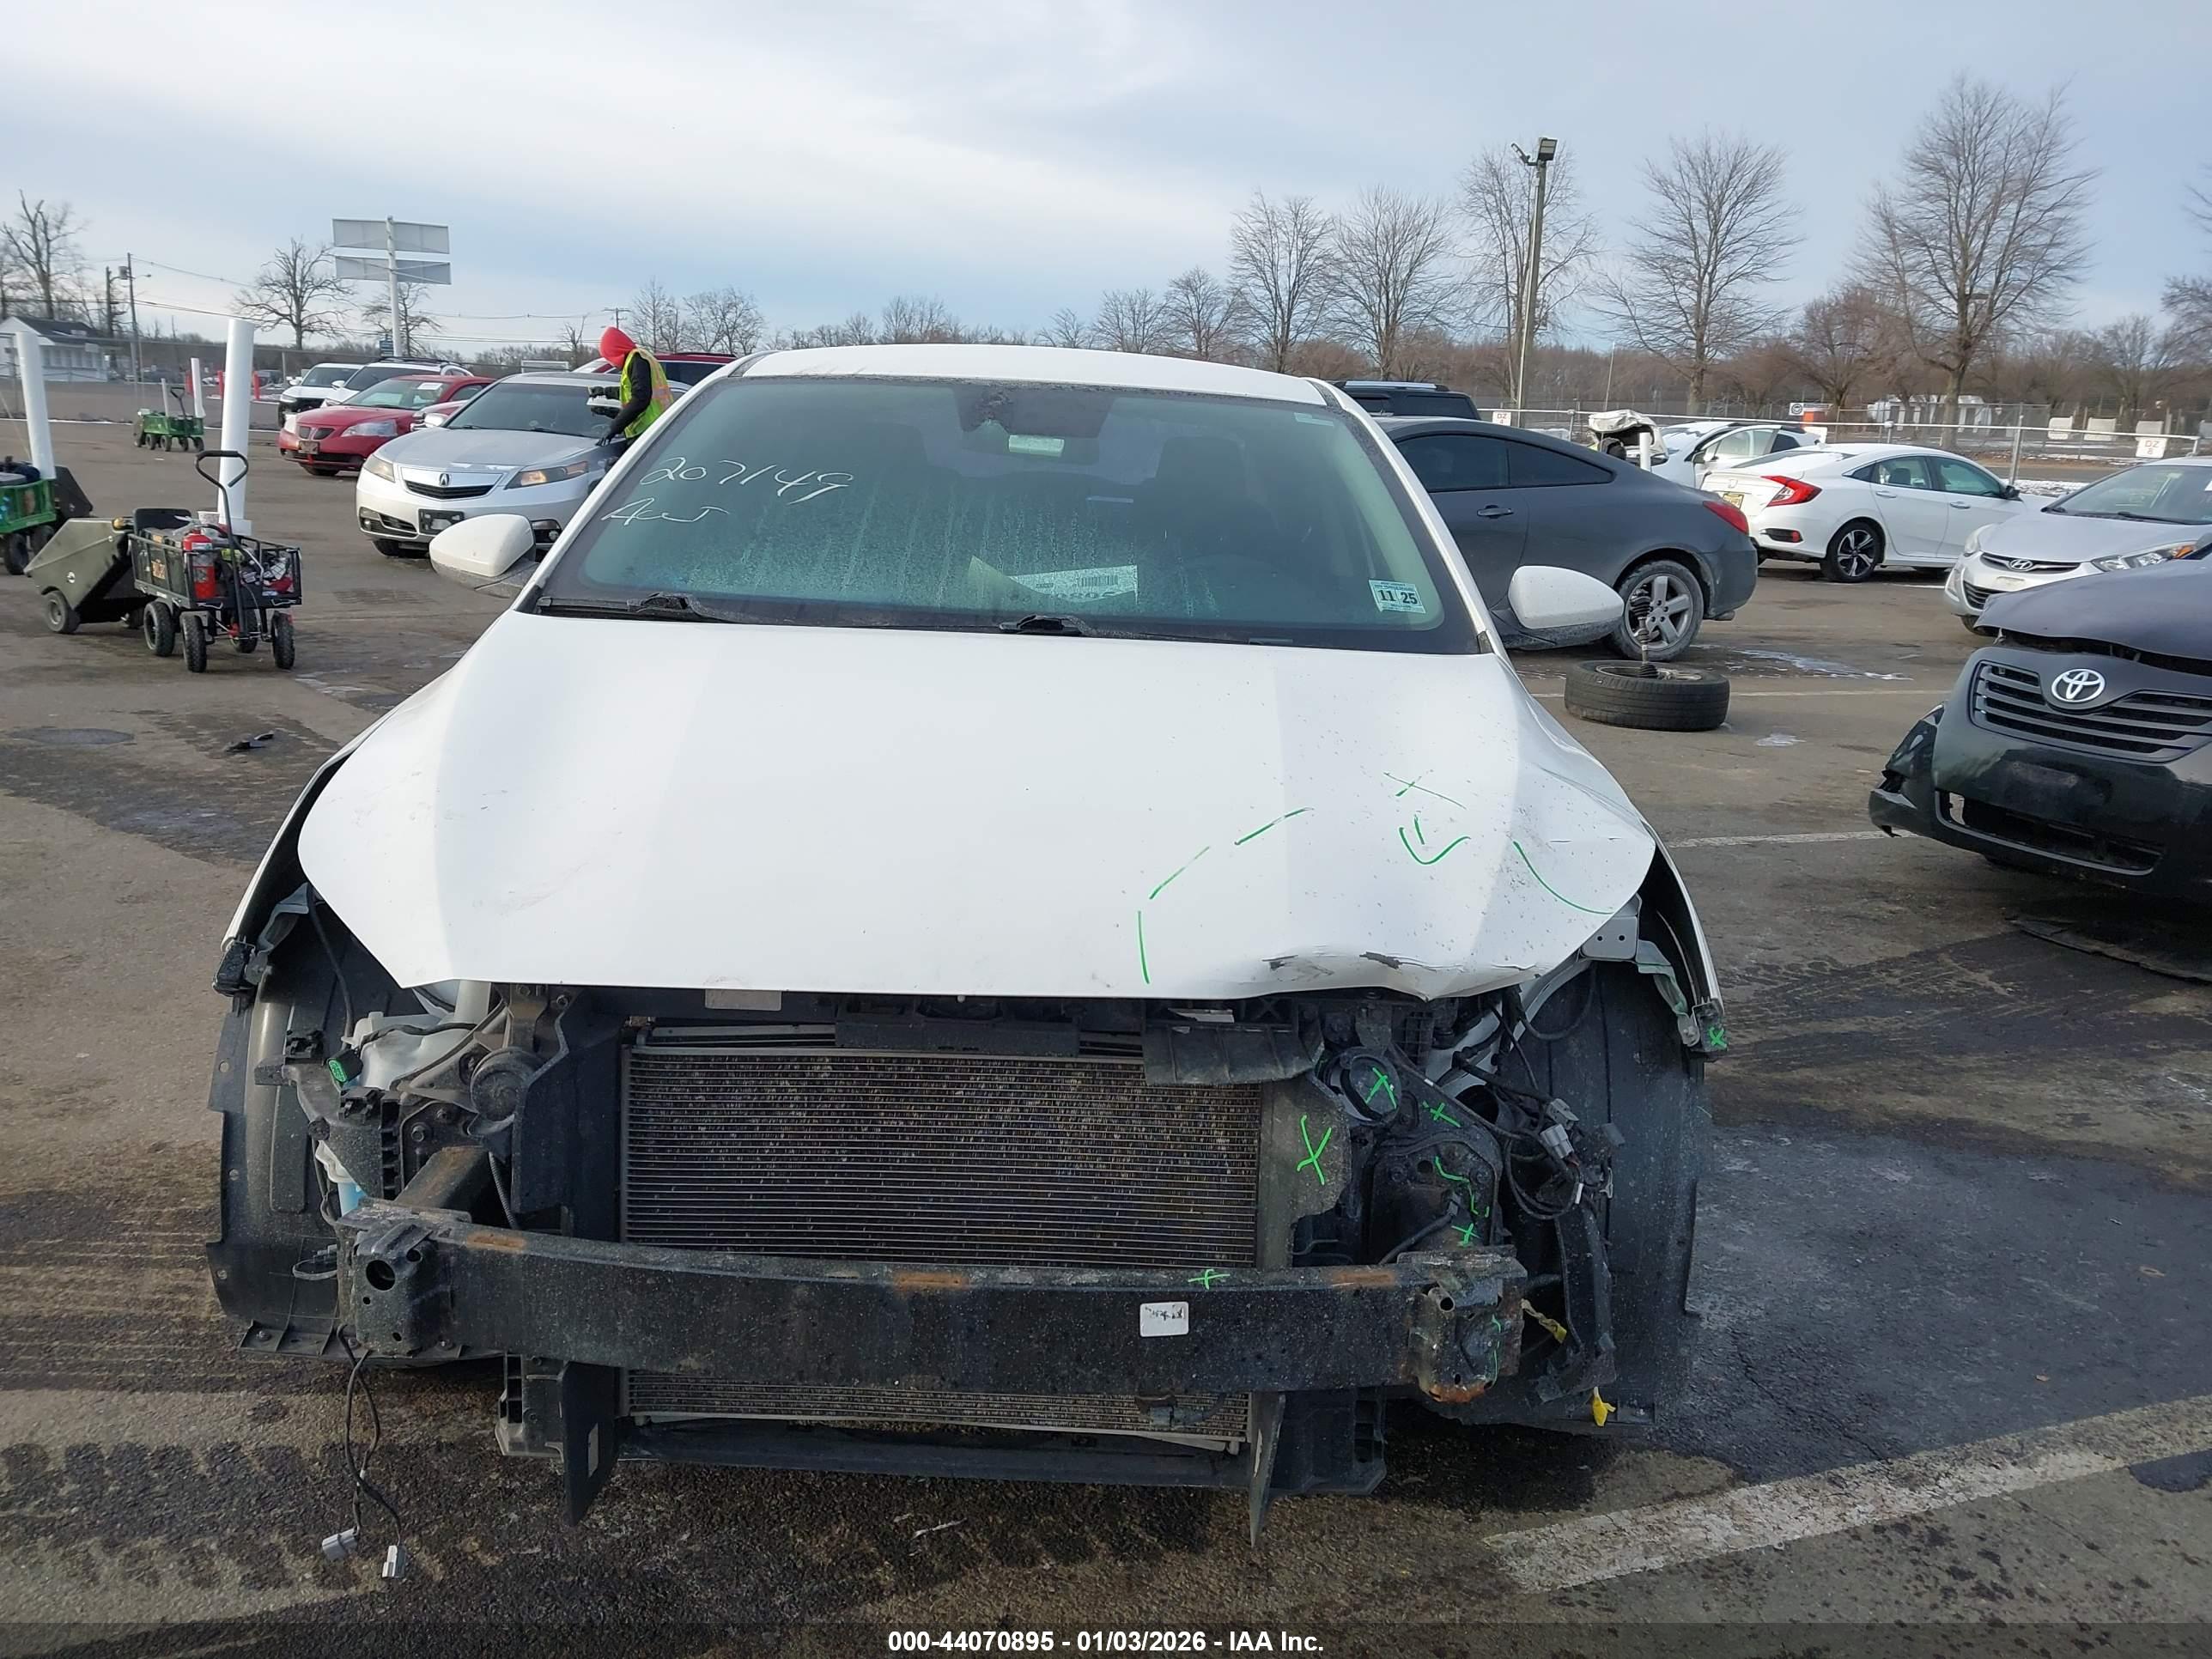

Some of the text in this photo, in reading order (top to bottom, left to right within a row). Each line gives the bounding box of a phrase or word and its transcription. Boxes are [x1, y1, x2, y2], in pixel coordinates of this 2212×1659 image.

[640, 457, 854, 505] 207149
[1378, 590, 1418, 605] 11 25
